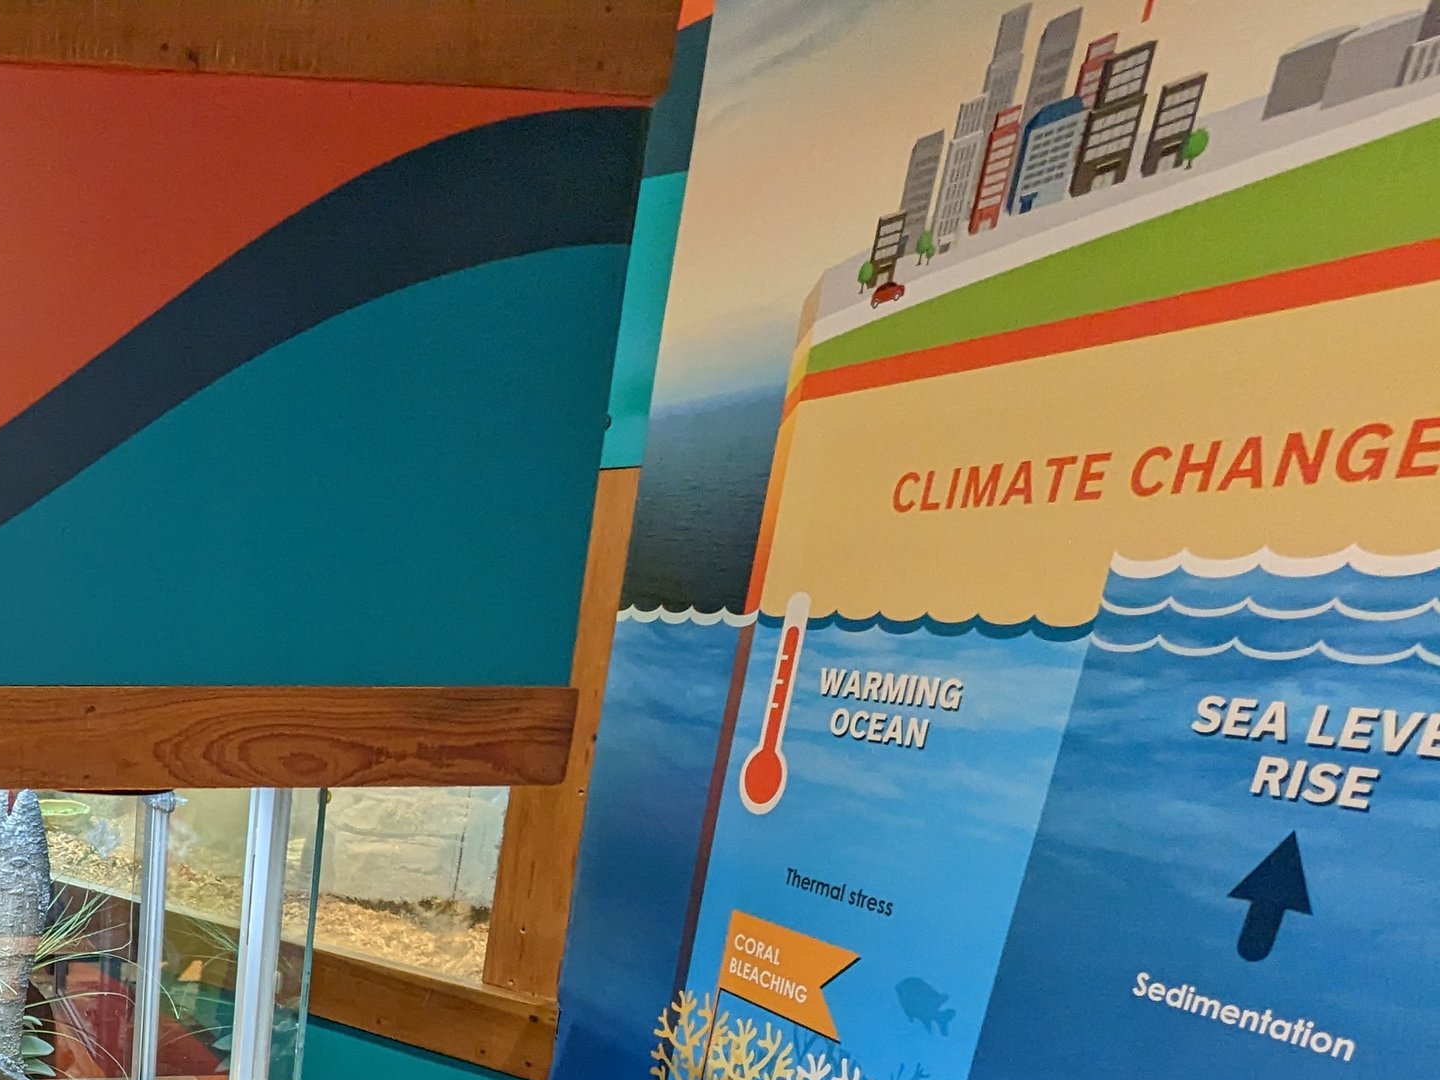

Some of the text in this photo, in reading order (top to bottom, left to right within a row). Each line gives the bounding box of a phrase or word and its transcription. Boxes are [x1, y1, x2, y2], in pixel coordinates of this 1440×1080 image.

[891, 417, 1440, 513] CLIMATE CHANGE
[820, 667, 964, 712] WARMING
[830, 708, 930, 749] OCEAN
[1191, 695, 1290, 741] SEA
[1250, 756, 1380, 812] RISE
[786, 867, 895, 917] Thermal stress
[734, 933, 781, 966] CORAL
[729, 957, 808, 1004] BLEACHING
[1132, 971, 1357, 1063] Sedimentation
